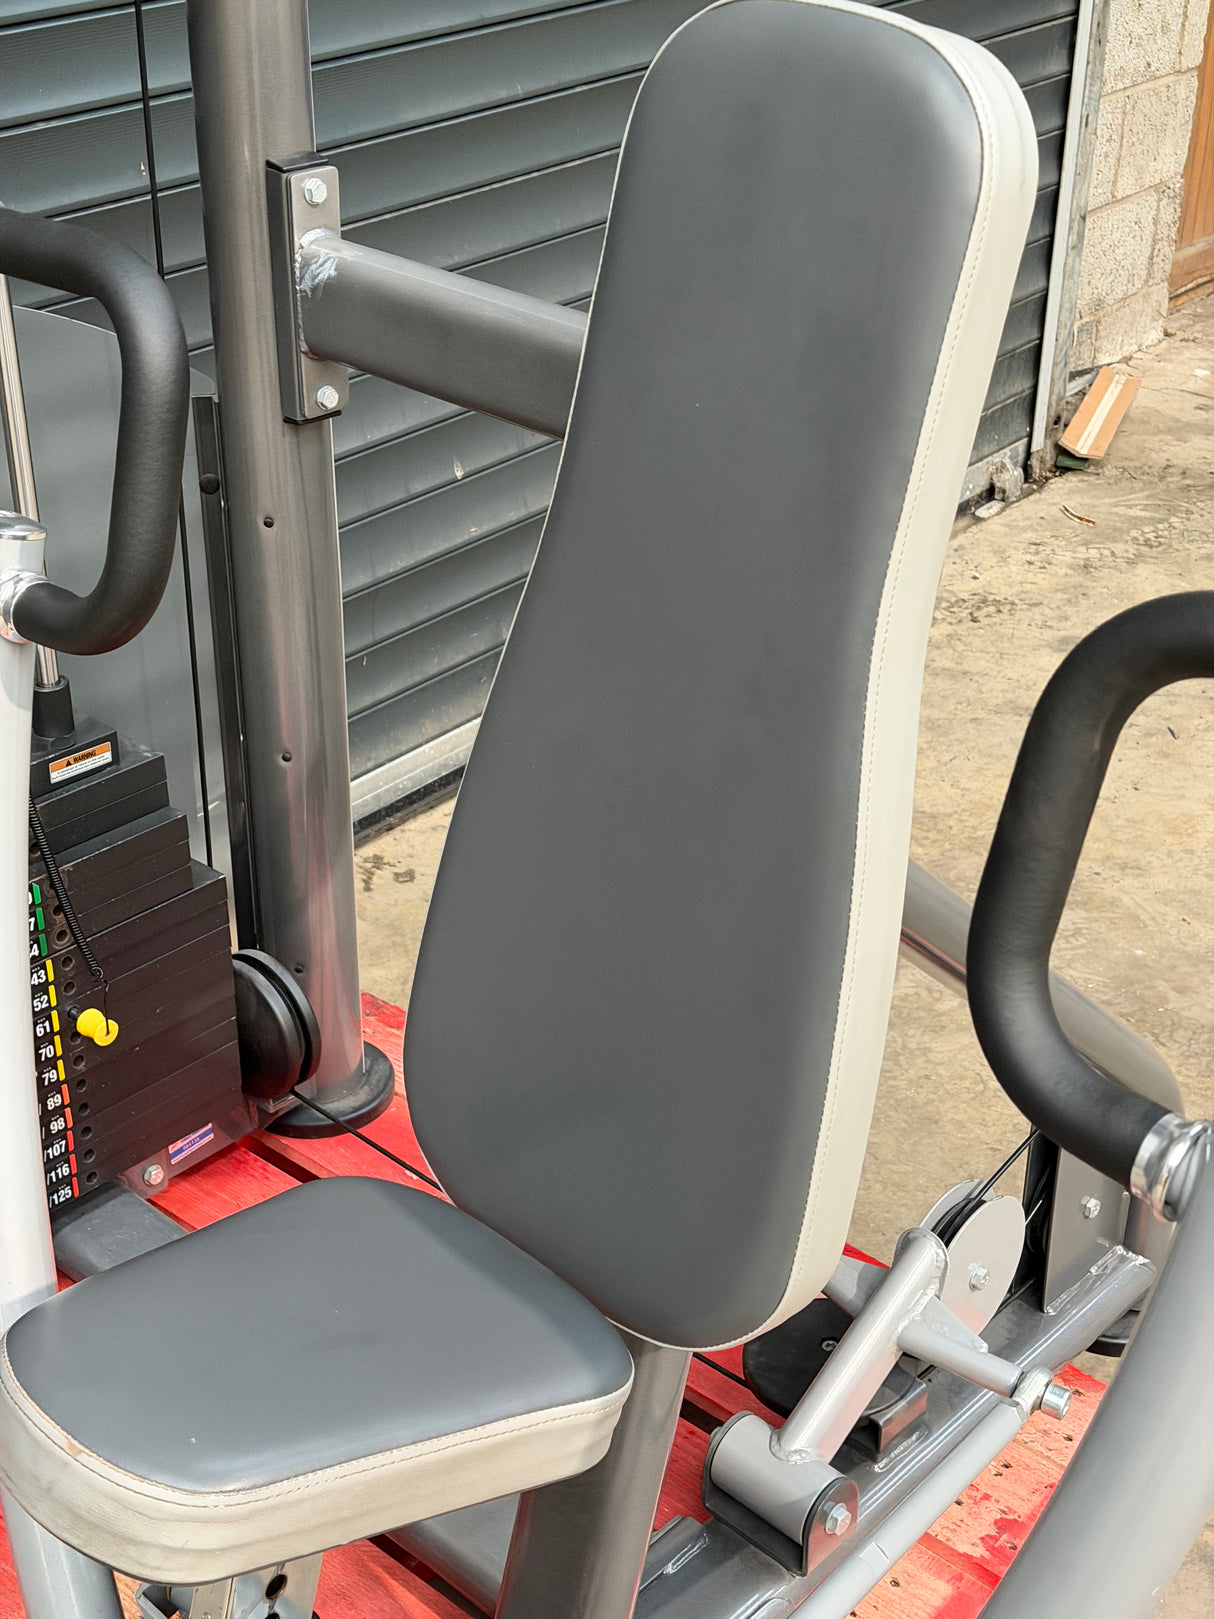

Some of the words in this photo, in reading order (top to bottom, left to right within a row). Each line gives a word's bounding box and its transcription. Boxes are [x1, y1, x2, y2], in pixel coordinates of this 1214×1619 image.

[31, 969, 46, 985] 43
[33, 994, 49, 1012] 52
[35, 1020, 51, 1037] 61
[38, 1045, 55, 1061] 70
[41, 1069, 58, 1086] 79
[46, 1093, 62, 1111] 89
[49, 1117, 66, 1134] 98
